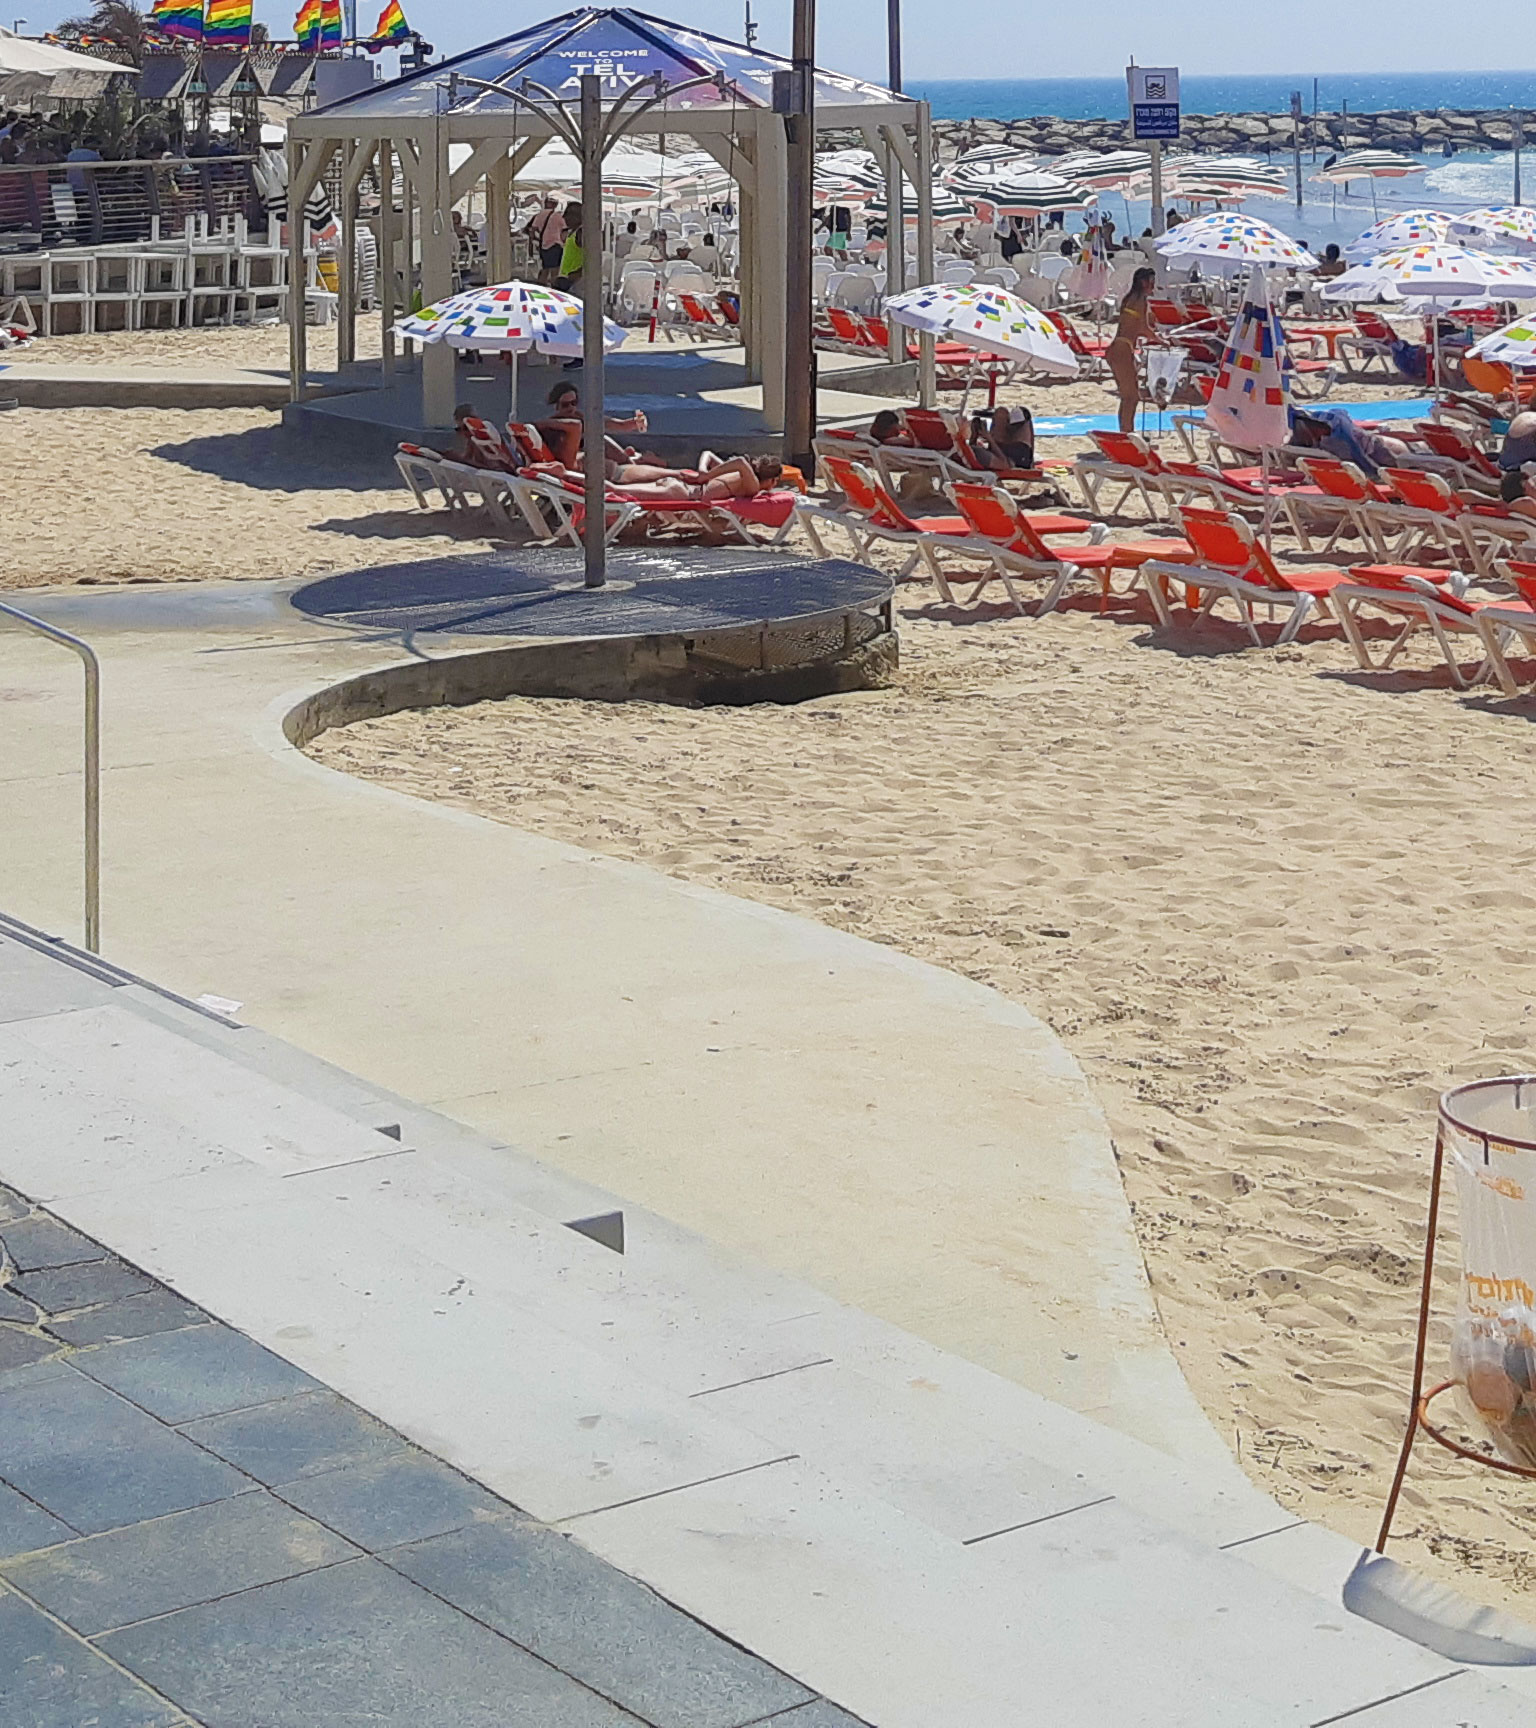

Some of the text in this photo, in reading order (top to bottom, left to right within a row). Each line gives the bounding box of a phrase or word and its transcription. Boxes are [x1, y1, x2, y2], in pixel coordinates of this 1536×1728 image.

[559, 49, 649, 58] WELCOME
[569, 63, 636, 76] TEL
[560, 74, 645, 89] AIV
